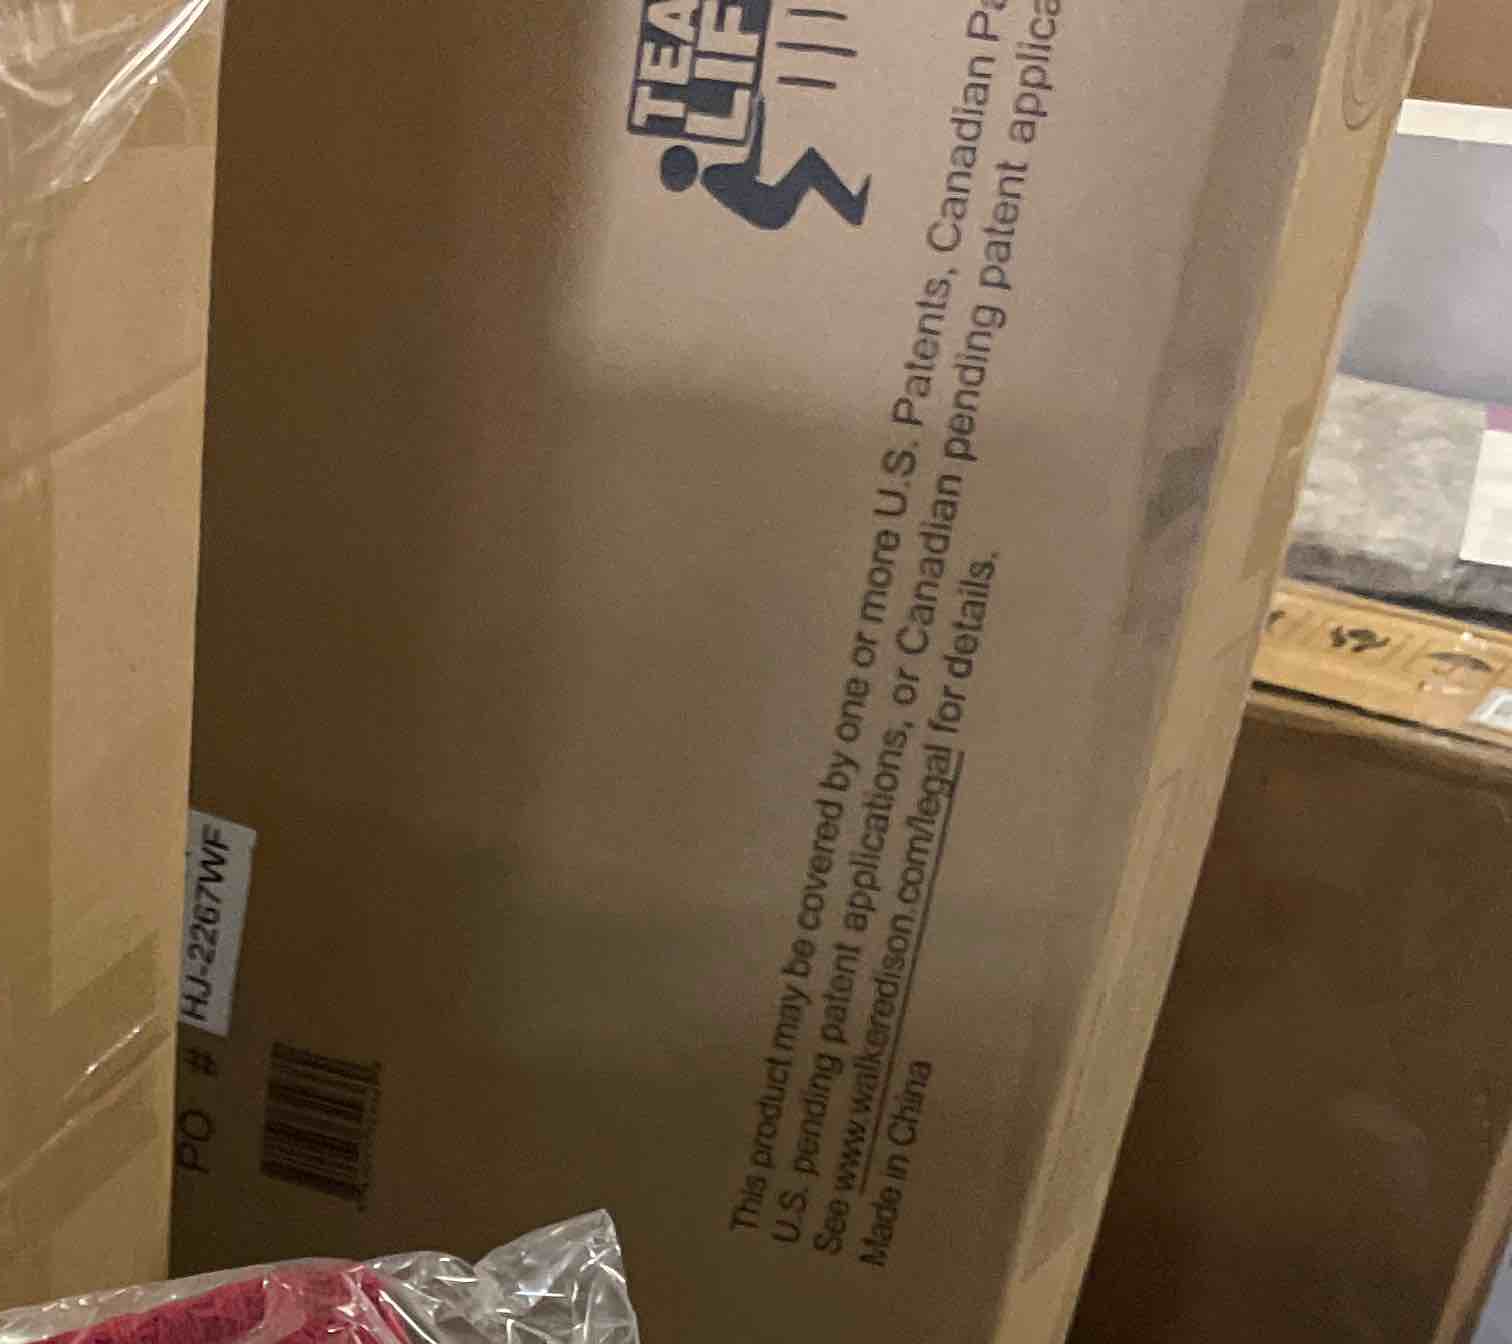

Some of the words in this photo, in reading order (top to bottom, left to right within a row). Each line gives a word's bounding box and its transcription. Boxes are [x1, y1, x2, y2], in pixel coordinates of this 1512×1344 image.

[926, 54, 996, 252] Canadian
[978, 160, 1029, 291] patent
[892, 267, 959, 427] Patents,
[944, 303, 1007, 464] pending
[873, 441, 920, 518] U.S.
[860, 529, 901, 623] more
[896, 474, 963, 655] Canadian
[852, 631, 878, 668] or
[943, 551, 1000, 680] details.
[836, 677, 870, 743] one
[892, 665, 919, 706] or
[927, 685, 967, 733] for
[818, 749, 860, 792] by
[798, 799, 844, 932] covered
[843, 721, 915, 932] applications,
[781, 938, 816, 978] be
[820, 943, 862, 1044] patent
[835, 744, 960, 1192] www.walkeredison.com/legal
[773, 984, 812, 1050] may
[178, 1108, 214, 1176] PO
[750, 1056, 792, 1169] product
[793, 1052, 844, 1176] pending
[888, 1060, 933, 1147] China
[730, 1175, 767, 1230] This
[886, 1153, 910, 1182] in
[771, 1187, 808, 1244] U.S.
[813, 1199, 850, 1255] See
[858, 1186, 903, 1268] Made
